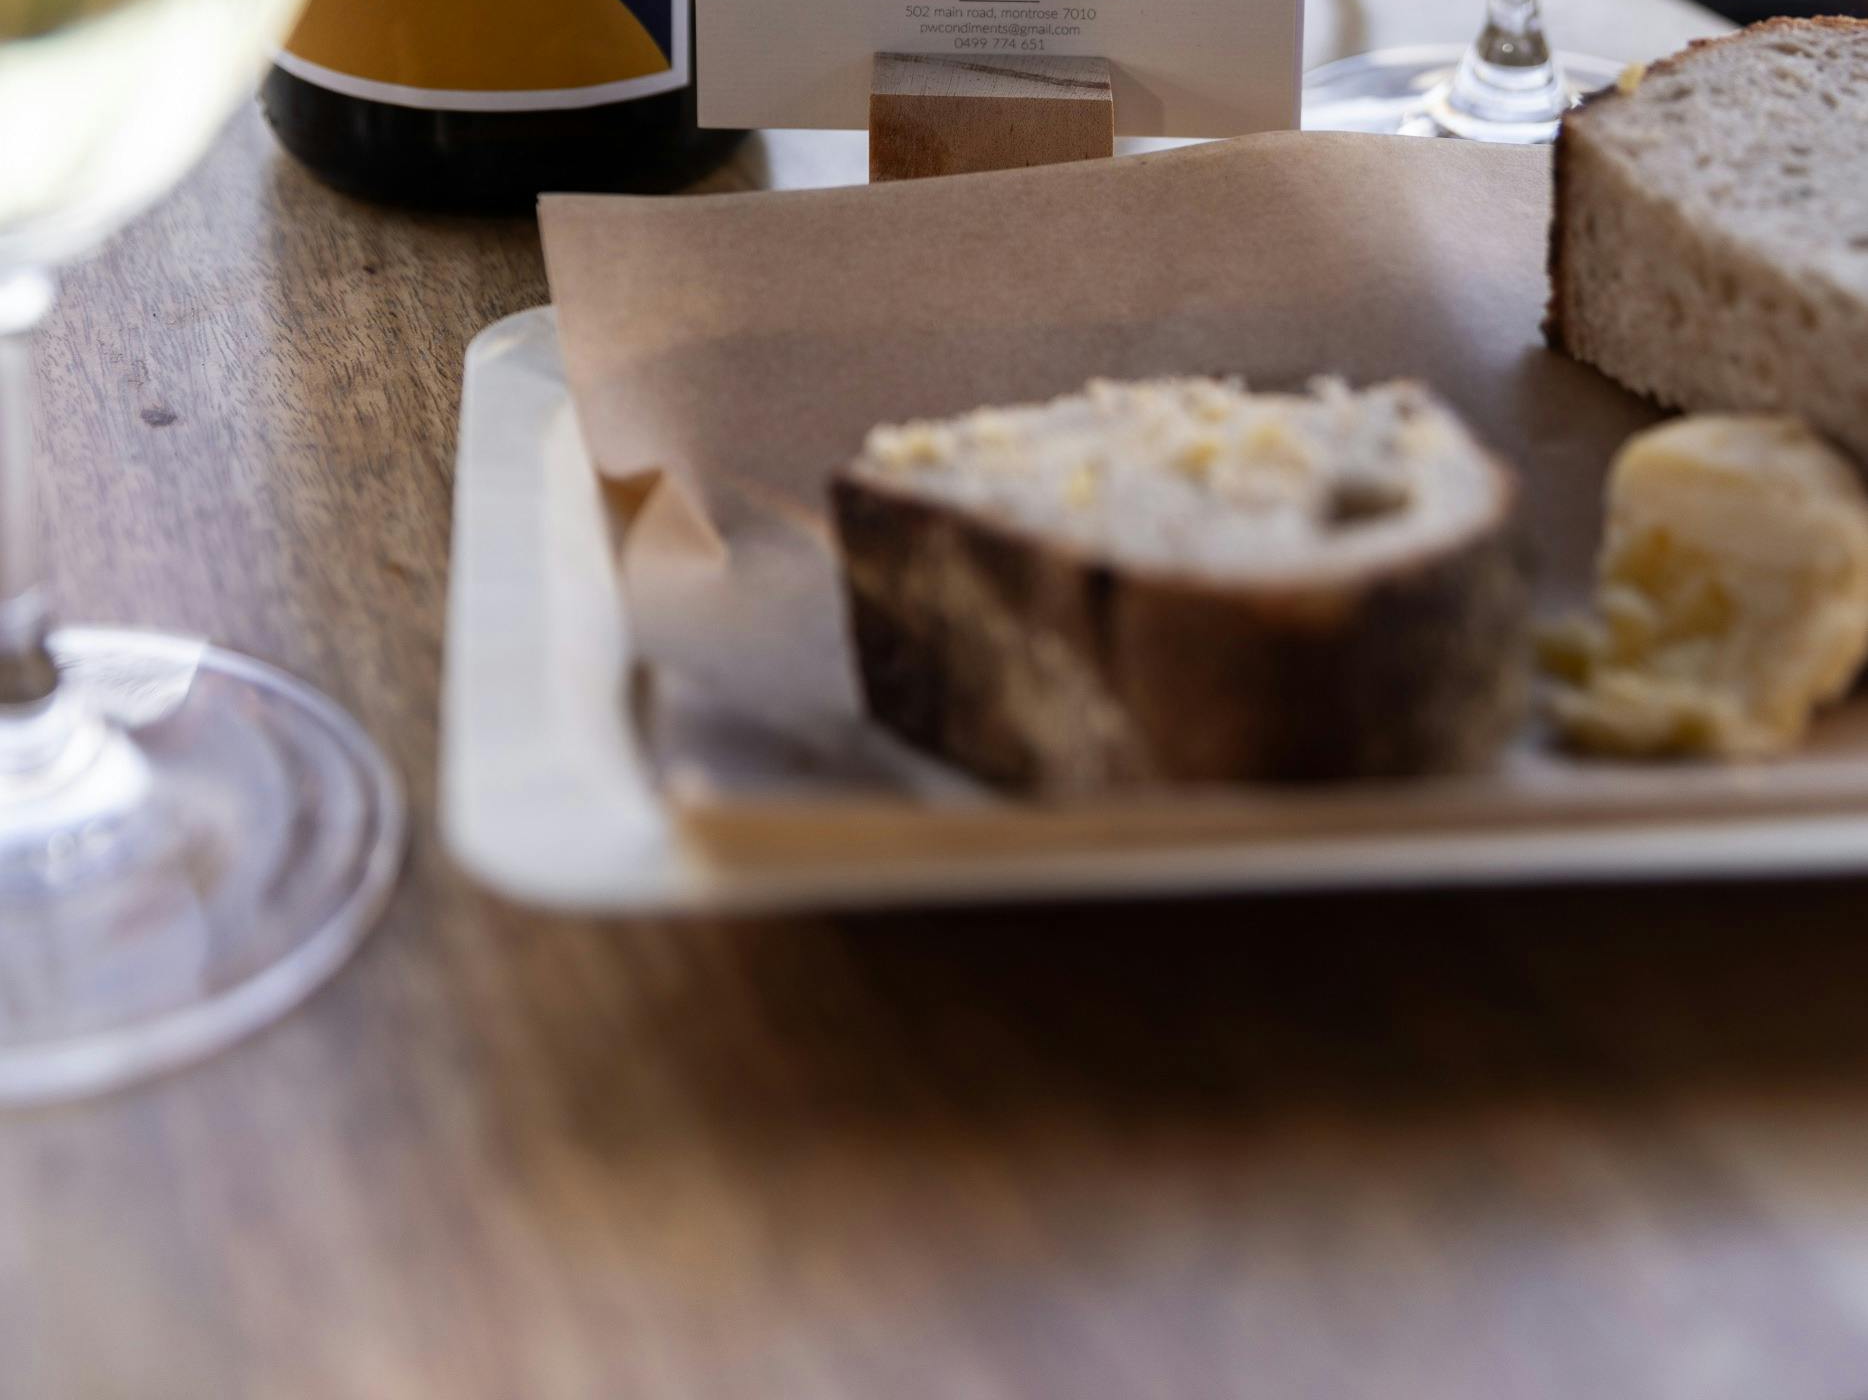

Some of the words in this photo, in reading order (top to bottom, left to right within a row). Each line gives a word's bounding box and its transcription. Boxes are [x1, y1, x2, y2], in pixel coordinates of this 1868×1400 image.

[904, 4, 931, 18] 502
[933, 6, 964, 18] main
[966, 7, 997, 20] road,
[1000, 7, 1059, 20] montrose
[1062, 7, 1097, 21] 7010
[919, 21, 1081, 37] pwcondiments@gmail.com
[953, 36, 988, 49] 0499
[992, 37, 1016, 49] 774
[1020, 38, 1045, 51] 651
